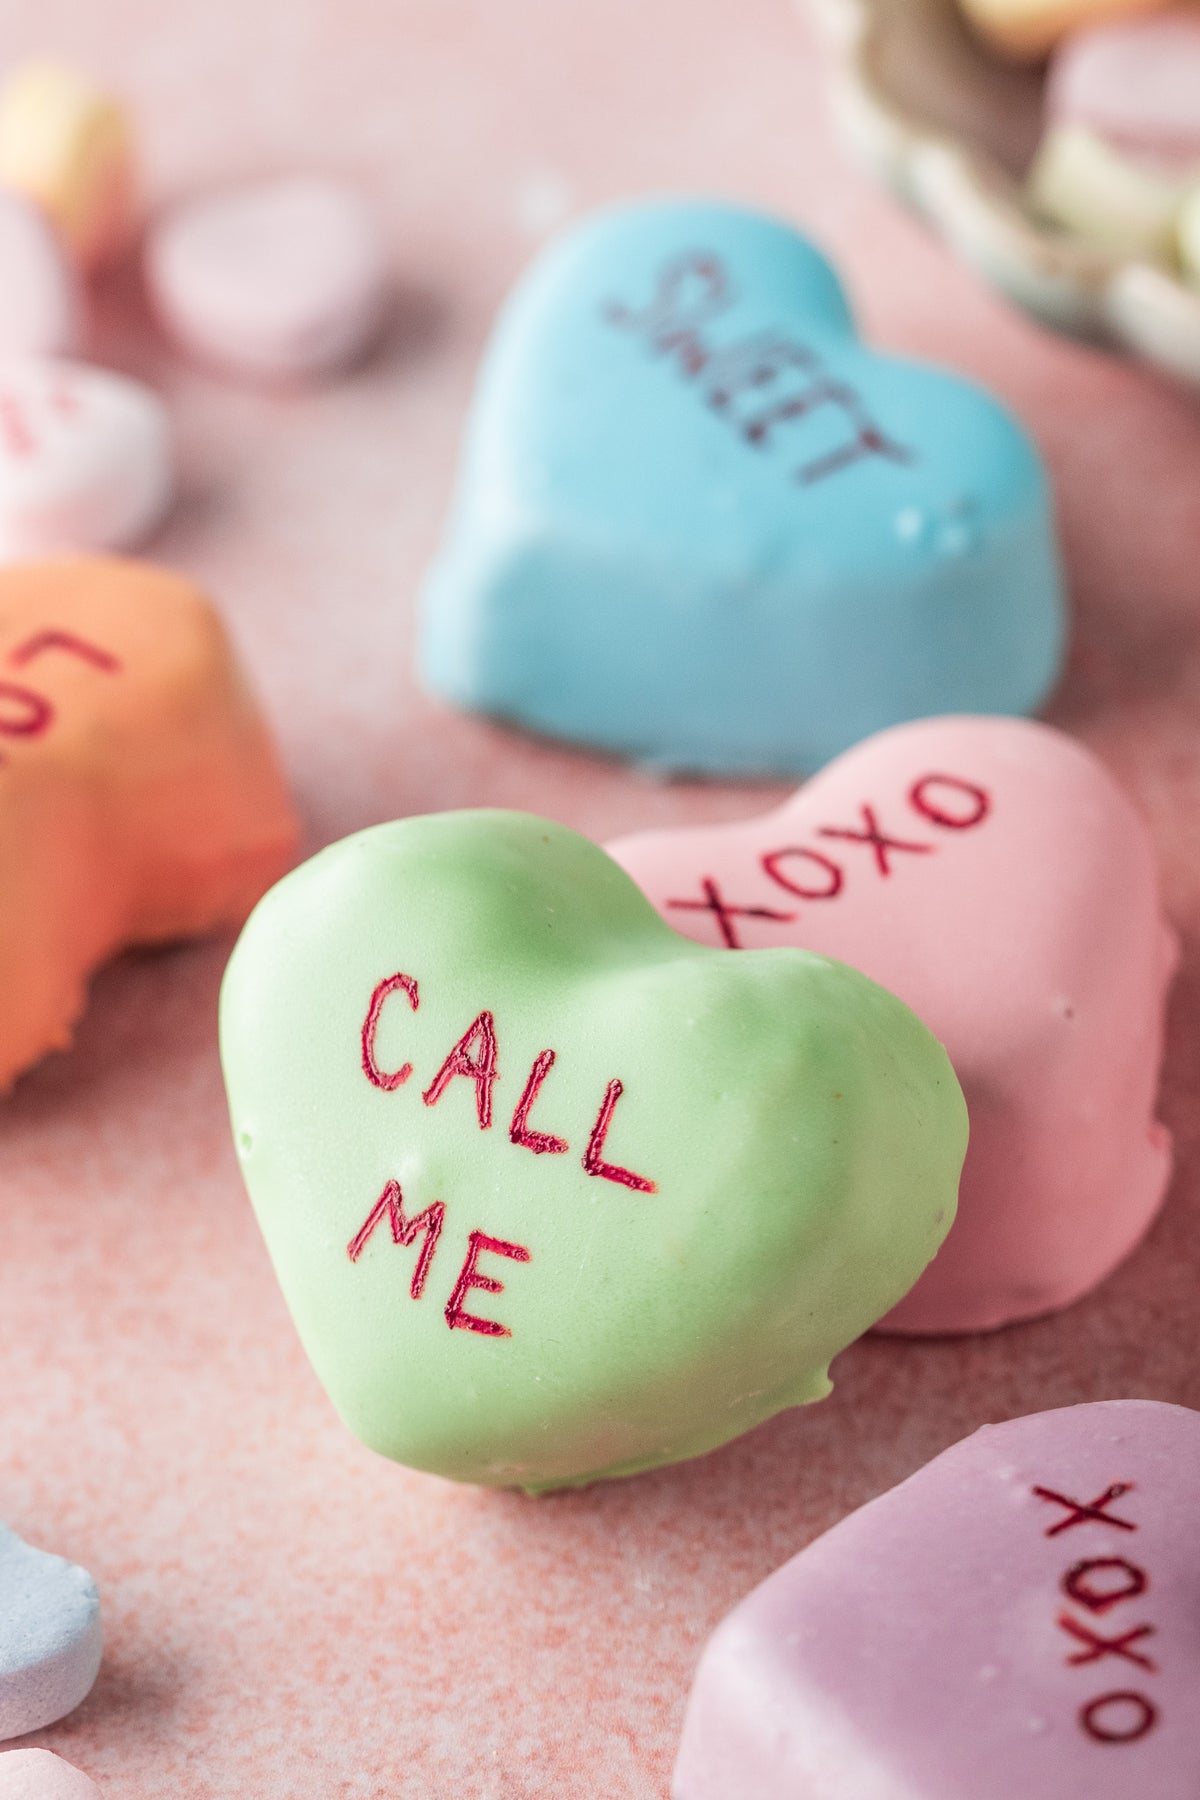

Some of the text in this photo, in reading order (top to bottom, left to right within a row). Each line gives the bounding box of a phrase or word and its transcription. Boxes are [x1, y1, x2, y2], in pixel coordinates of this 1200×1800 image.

[665, 771, 992, 950] XOXO
[361, 971, 658, 1194] CALL
[347, 1179, 531, 1338] ME
[1031, 1479, 1160, 1747] XOXO
